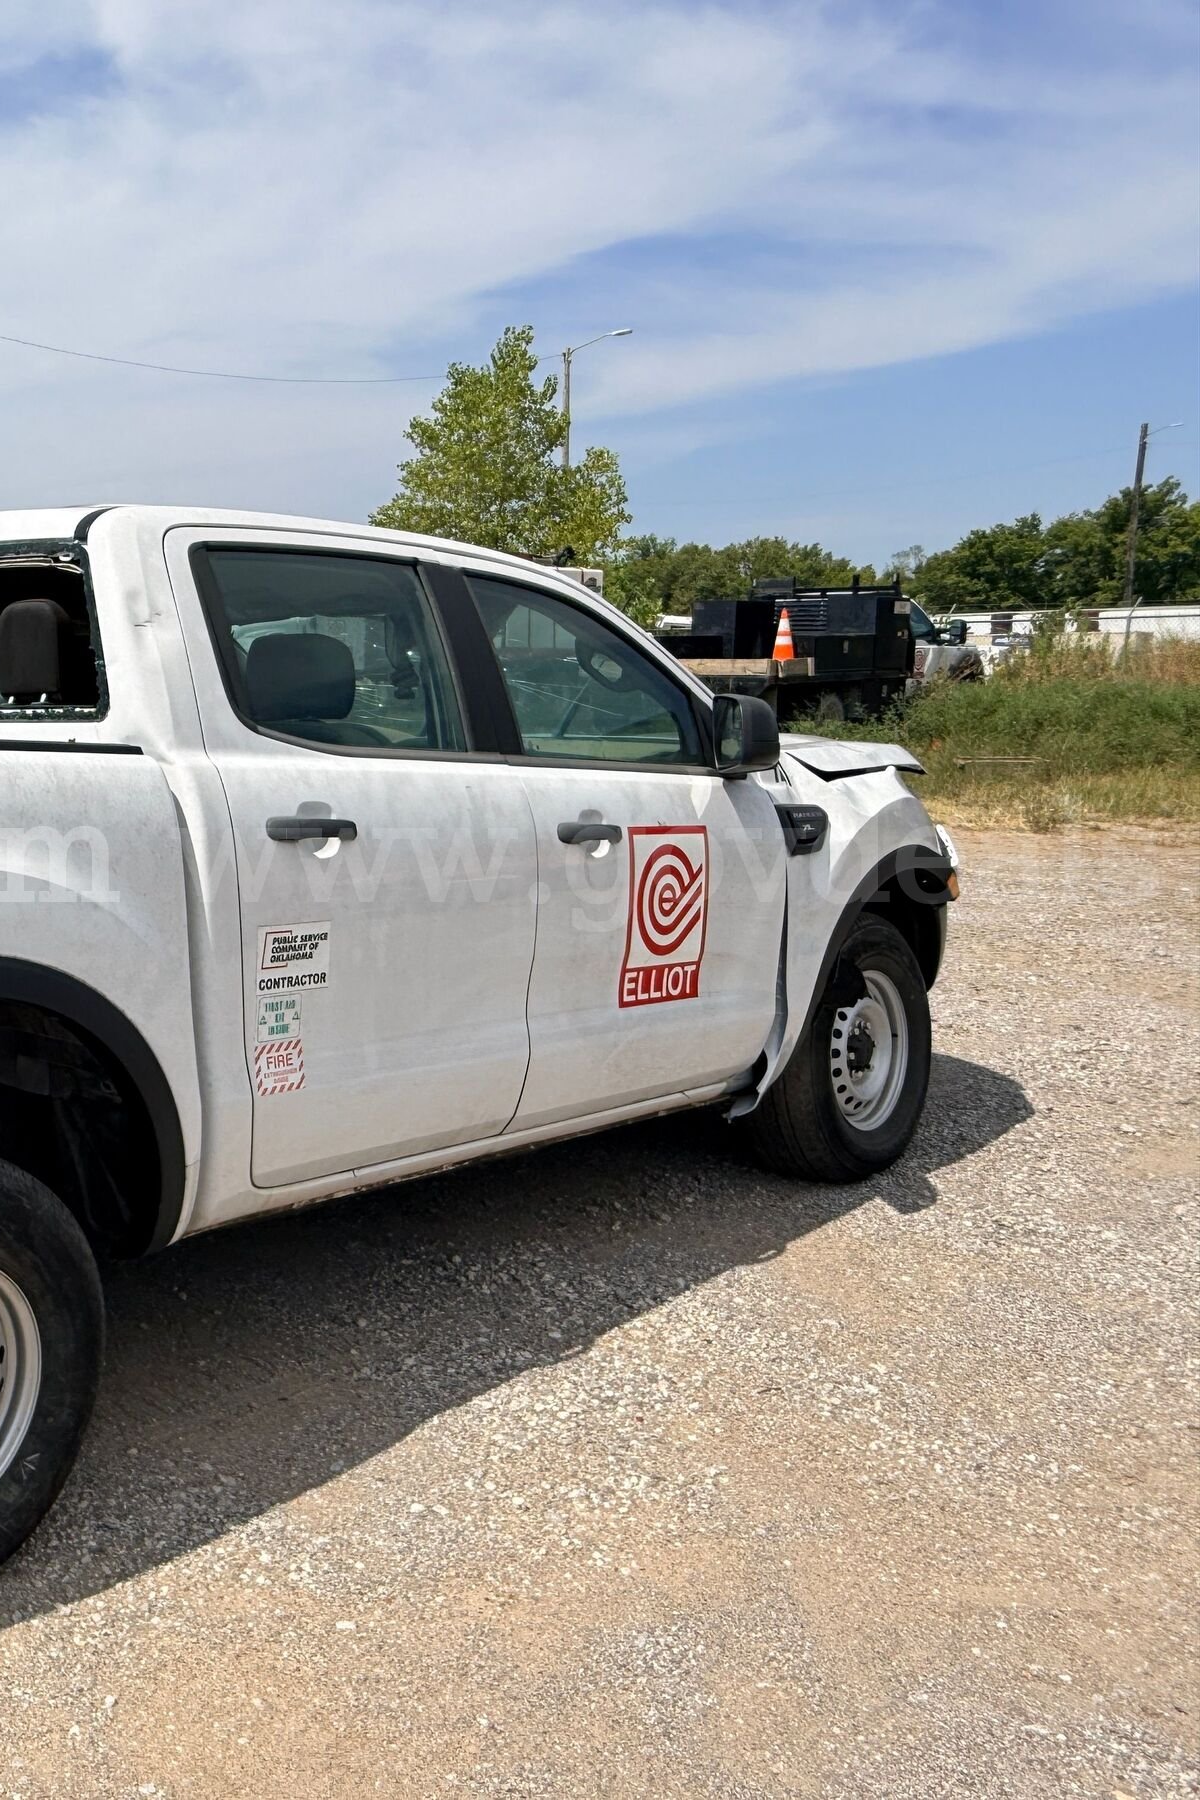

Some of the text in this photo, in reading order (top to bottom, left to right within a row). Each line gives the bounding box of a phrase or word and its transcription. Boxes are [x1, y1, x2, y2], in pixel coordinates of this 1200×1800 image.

[272, 932, 328, 945] PUBLIC SERVICE
[309, 942, 319, 950] OF
[270, 951, 313, 963] OKLAHOMA
[259, 972, 327, 991] CONTRACTOR
[623, 964, 696, 1002] ELLIOT
[266, 1053, 293, 1070] FIRE
